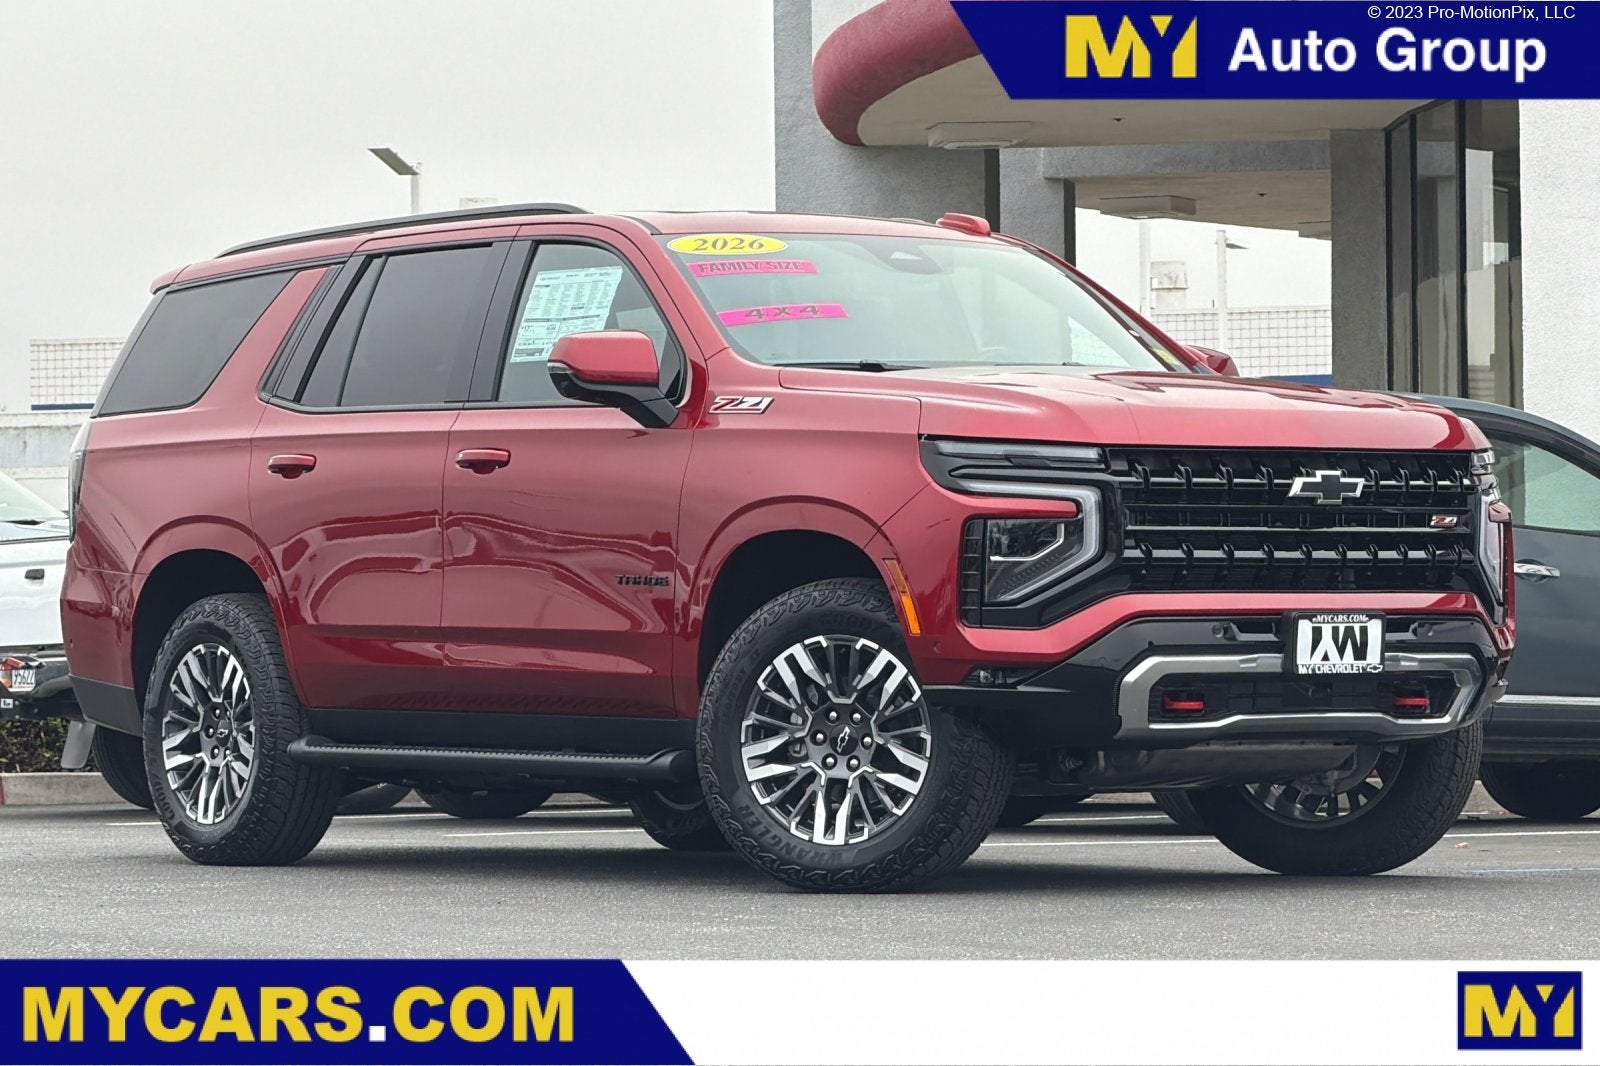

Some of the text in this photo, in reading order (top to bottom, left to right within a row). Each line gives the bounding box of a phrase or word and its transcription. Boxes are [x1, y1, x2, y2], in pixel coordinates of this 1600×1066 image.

[692, 237, 765, 252] 2026
[699, 261, 804, 273] FAMILY SIZE
[615, 574, 670, 587] TAHOE
[1315, 614, 1367, 623] MYCARS.COM
[1298, 664, 1364, 675] MY CHEVROLET
